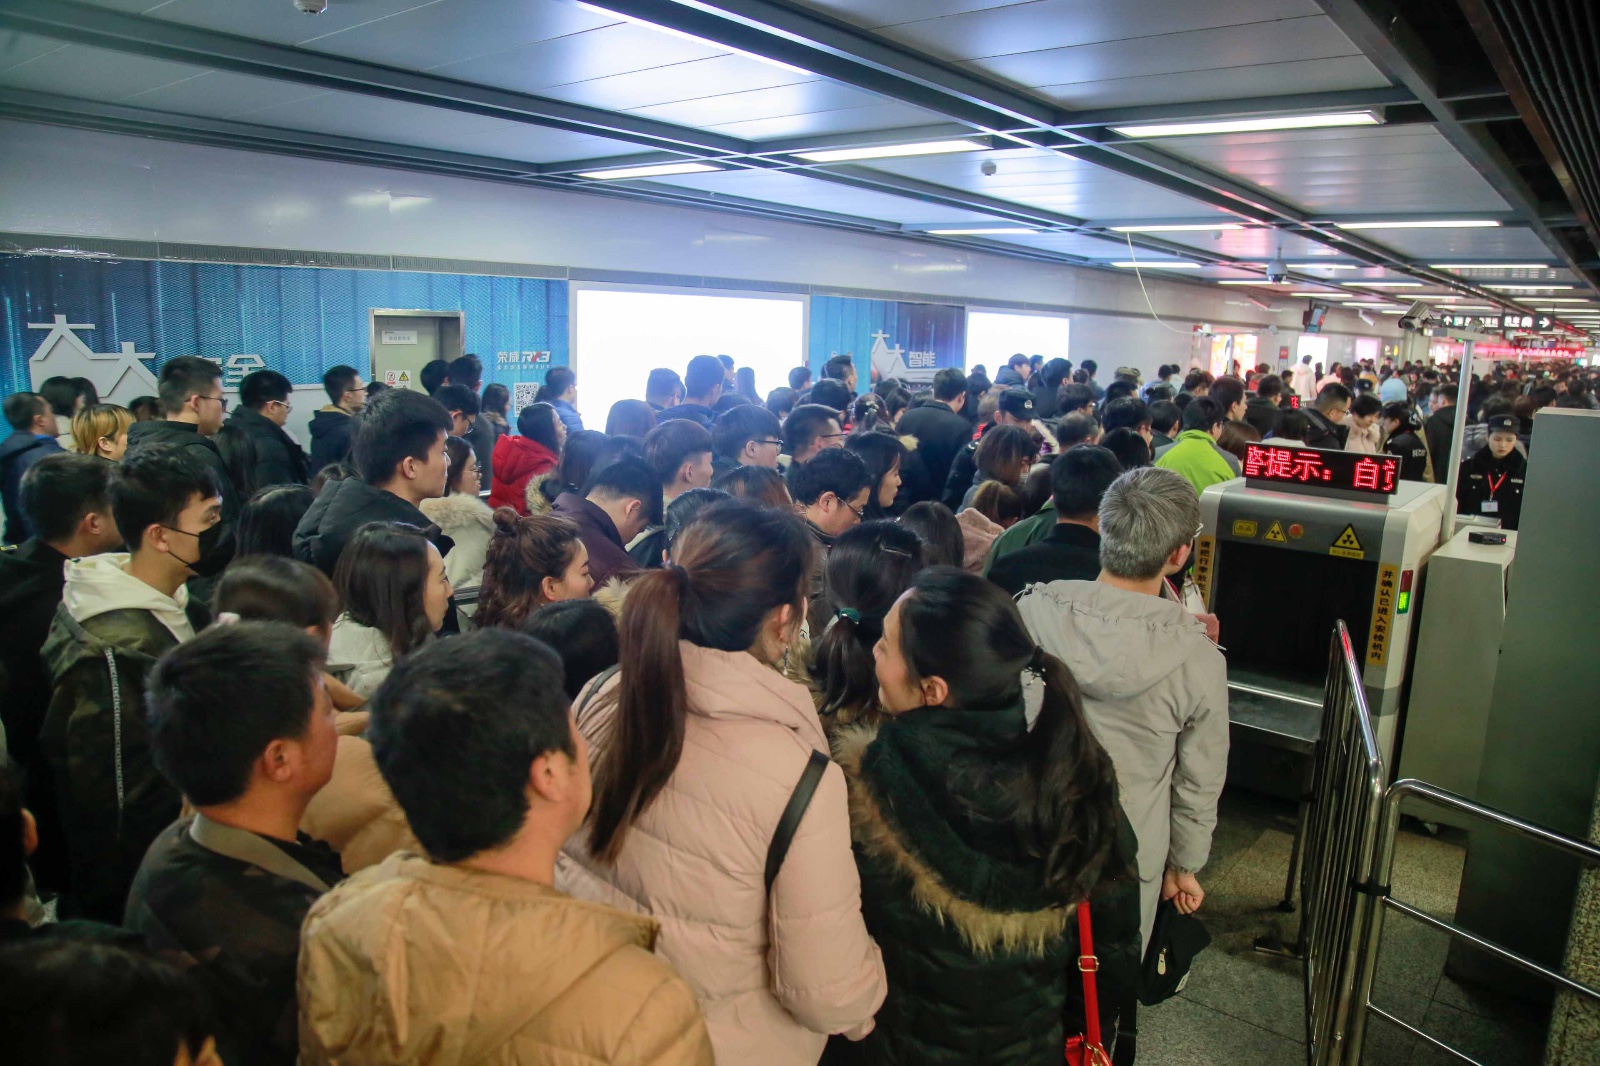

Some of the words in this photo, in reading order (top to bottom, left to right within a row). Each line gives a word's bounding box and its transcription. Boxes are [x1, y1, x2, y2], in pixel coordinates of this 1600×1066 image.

[497, 351, 519, 363] 荣威
[521, 351, 550, 363] RX3
[909, 351, 936, 367] 智能
[1371, 570, 1393, 660] 并确认已进入安检机内
